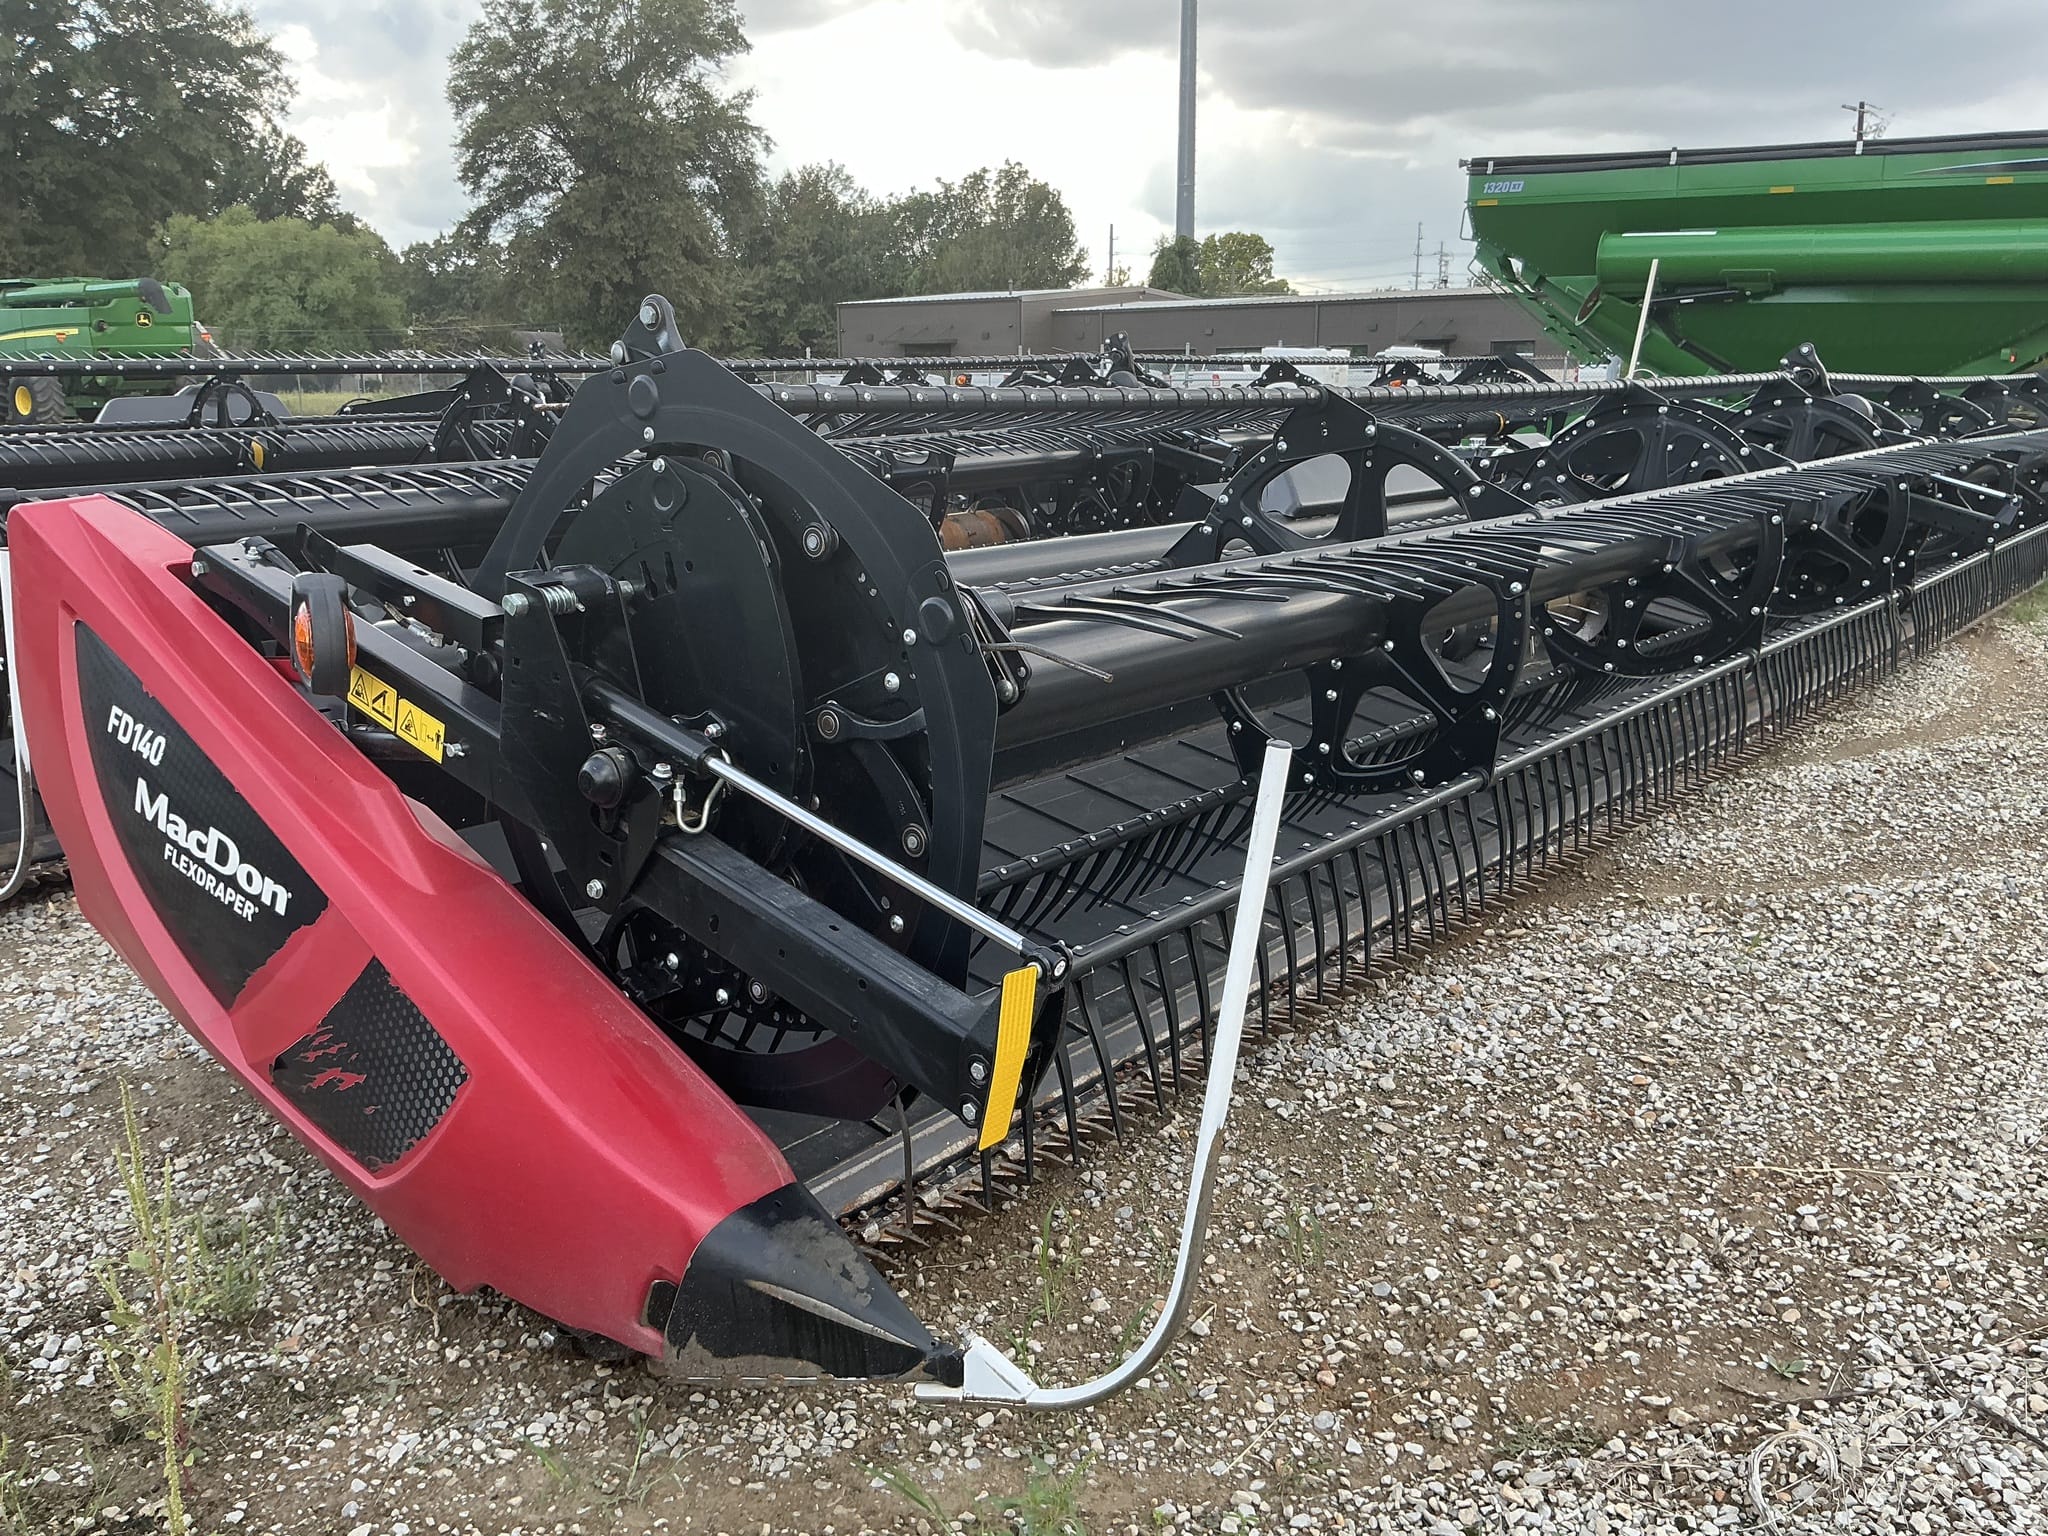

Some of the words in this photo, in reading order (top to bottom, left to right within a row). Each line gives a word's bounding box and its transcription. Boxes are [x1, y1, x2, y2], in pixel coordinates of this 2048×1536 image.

[106, 704, 166, 767] FD140
[134, 776, 290, 917] MacDon
[164, 842, 257, 922] FLEXDRAPER
